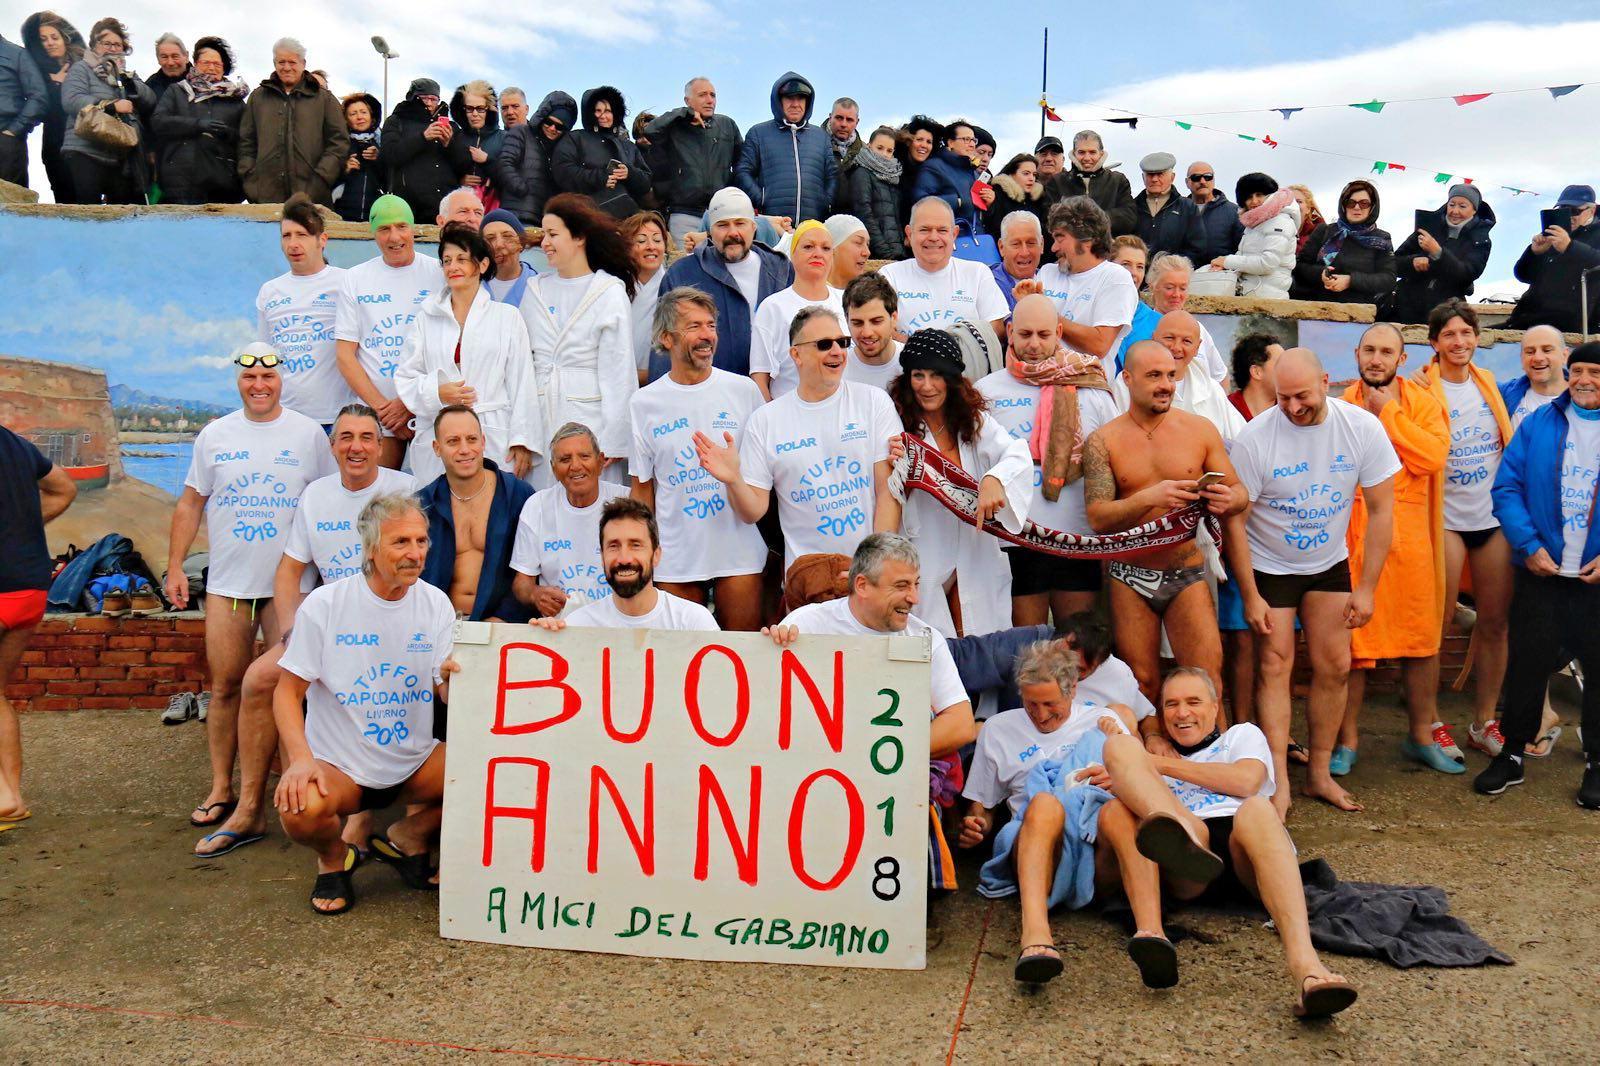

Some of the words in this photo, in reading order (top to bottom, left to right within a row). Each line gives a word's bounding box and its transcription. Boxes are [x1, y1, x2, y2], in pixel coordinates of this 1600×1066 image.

[357, 294, 392, 304] POLAR
[898, 291, 930, 300] POLAR
[1044, 289, 1068, 300] OLAR
[372, 313, 416, 334] TUFF
[364, 336, 404, 349] CAPOD
[995, 397, 1032, 408] POLAR
[653, 417, 689, 438] POLAR
[1451, 426, 1492, 441] UFFO
[776, 437, 818, 454] POLAR
[215, 450, 250, 462] POLAR
[1452, 456, 1485, 467] LIVORNO
[799, 455, 861, 486] TUFFO
[1273, 462, 1309, 479] POLAR
[1448, 465, 1488, 485] 2018
[226, 472, 287, 494] TUFFO
[790, 475, 871, 503] CAPODANN
[216, 495, 299, 508] CAPODANNO
[683, 493, 725, 519] 2018
[815, 495, 859, 513] LIVORNO
[1561, 500, 1589, 512] ORNO
[235, 510, 275, 519] LIVORNO
[816, 507, 866, 537] 2018
[233, 521, 278, 542] 2018
[317, 520, 352, 532] POLAR
[330, 543, 362, 566] TUF
[336, 633, 380, 646] POLAR
[353, 663, 418, 689] TUFFO
[490, 641, 845, 753] BUON
[364, 721, 409, 746] 2018
[1019, 744, 1041, 762] POL
[869, 688, 905, 901] 2018
[482, 756, 866, 892] ANNO
[486, 886, 596, 934] AMICI
[614, 905, 700, 938] DEL
[714, 917, 890, 957] GABBIANO
